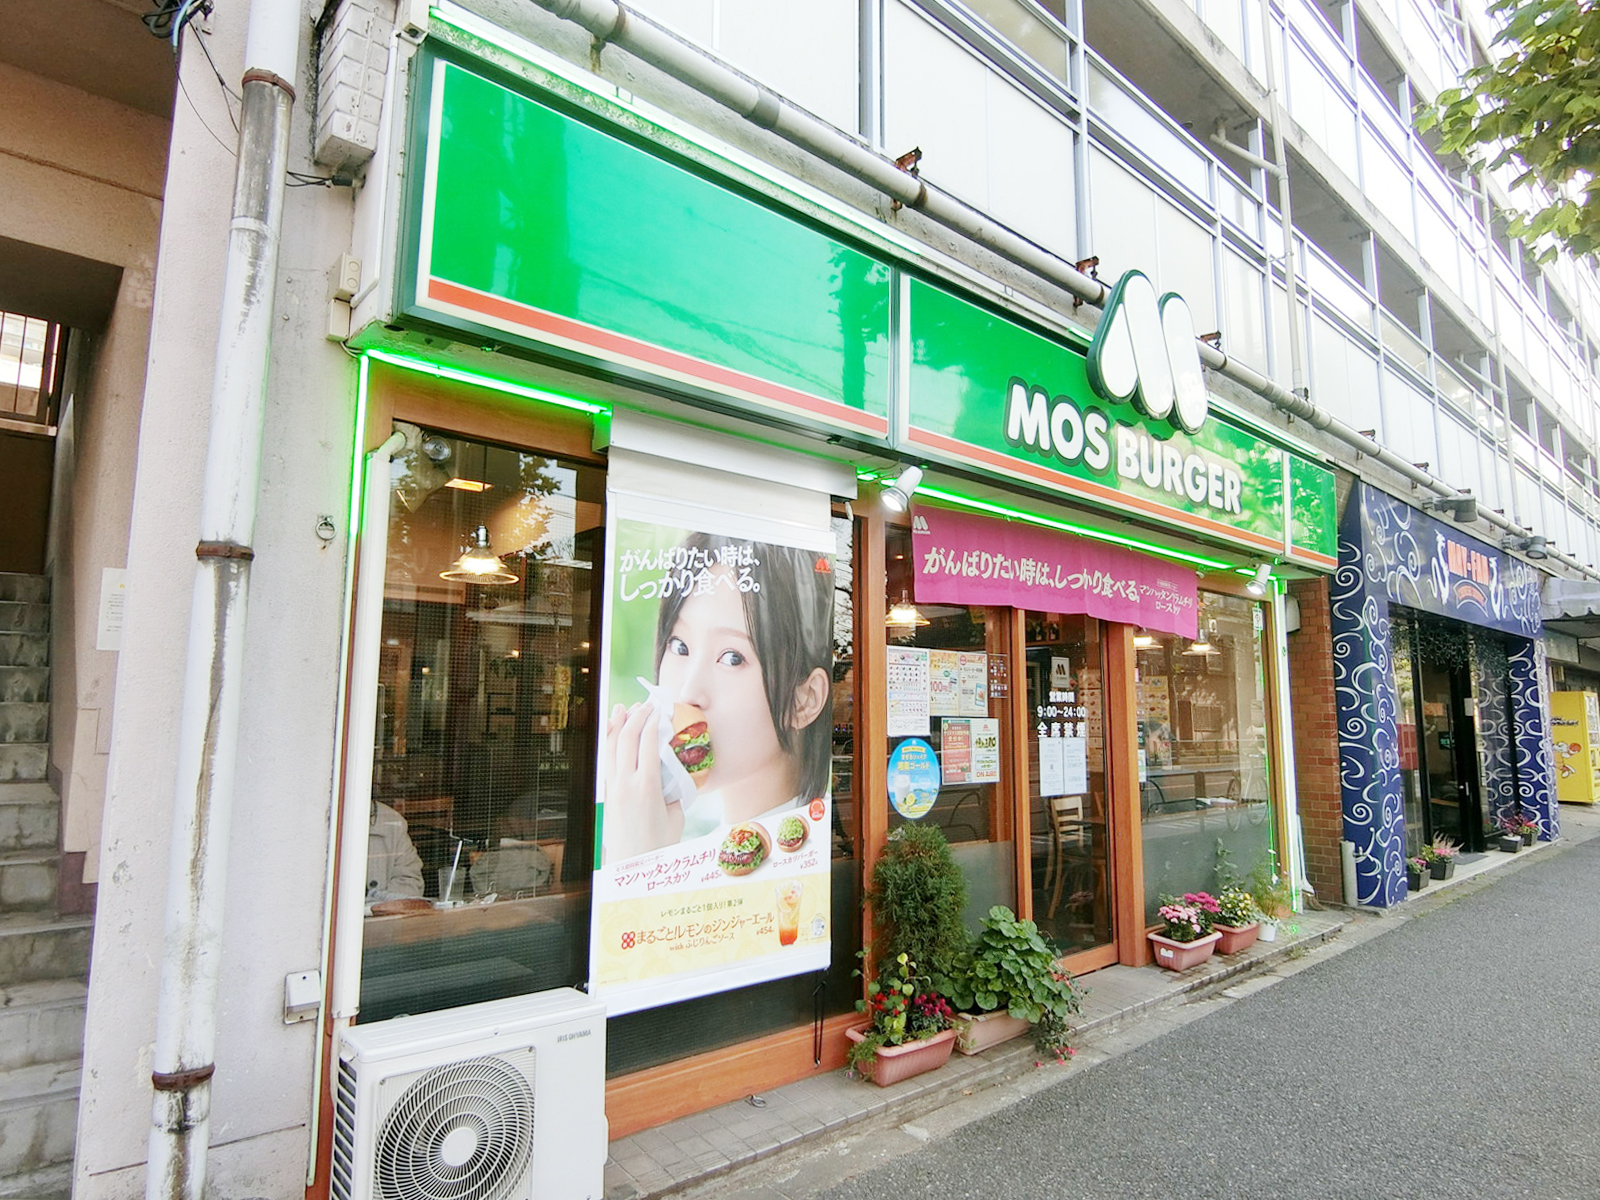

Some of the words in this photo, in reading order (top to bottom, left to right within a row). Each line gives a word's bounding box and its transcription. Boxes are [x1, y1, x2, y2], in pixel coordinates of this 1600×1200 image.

[1007, 383, 1110, 470] MOS
[1117, 426, 1242, 514] BURGER
[619, 545, 761, 573] がんばりたい時は、
[619, 567, 761, 602] しっかり食べる。
[1037, 721, 1086, 738] 全席禁煙
[614, 848, 717, 887] マンハッタンクラムチリ
[646, 870, 691, 891] ロースカツ
